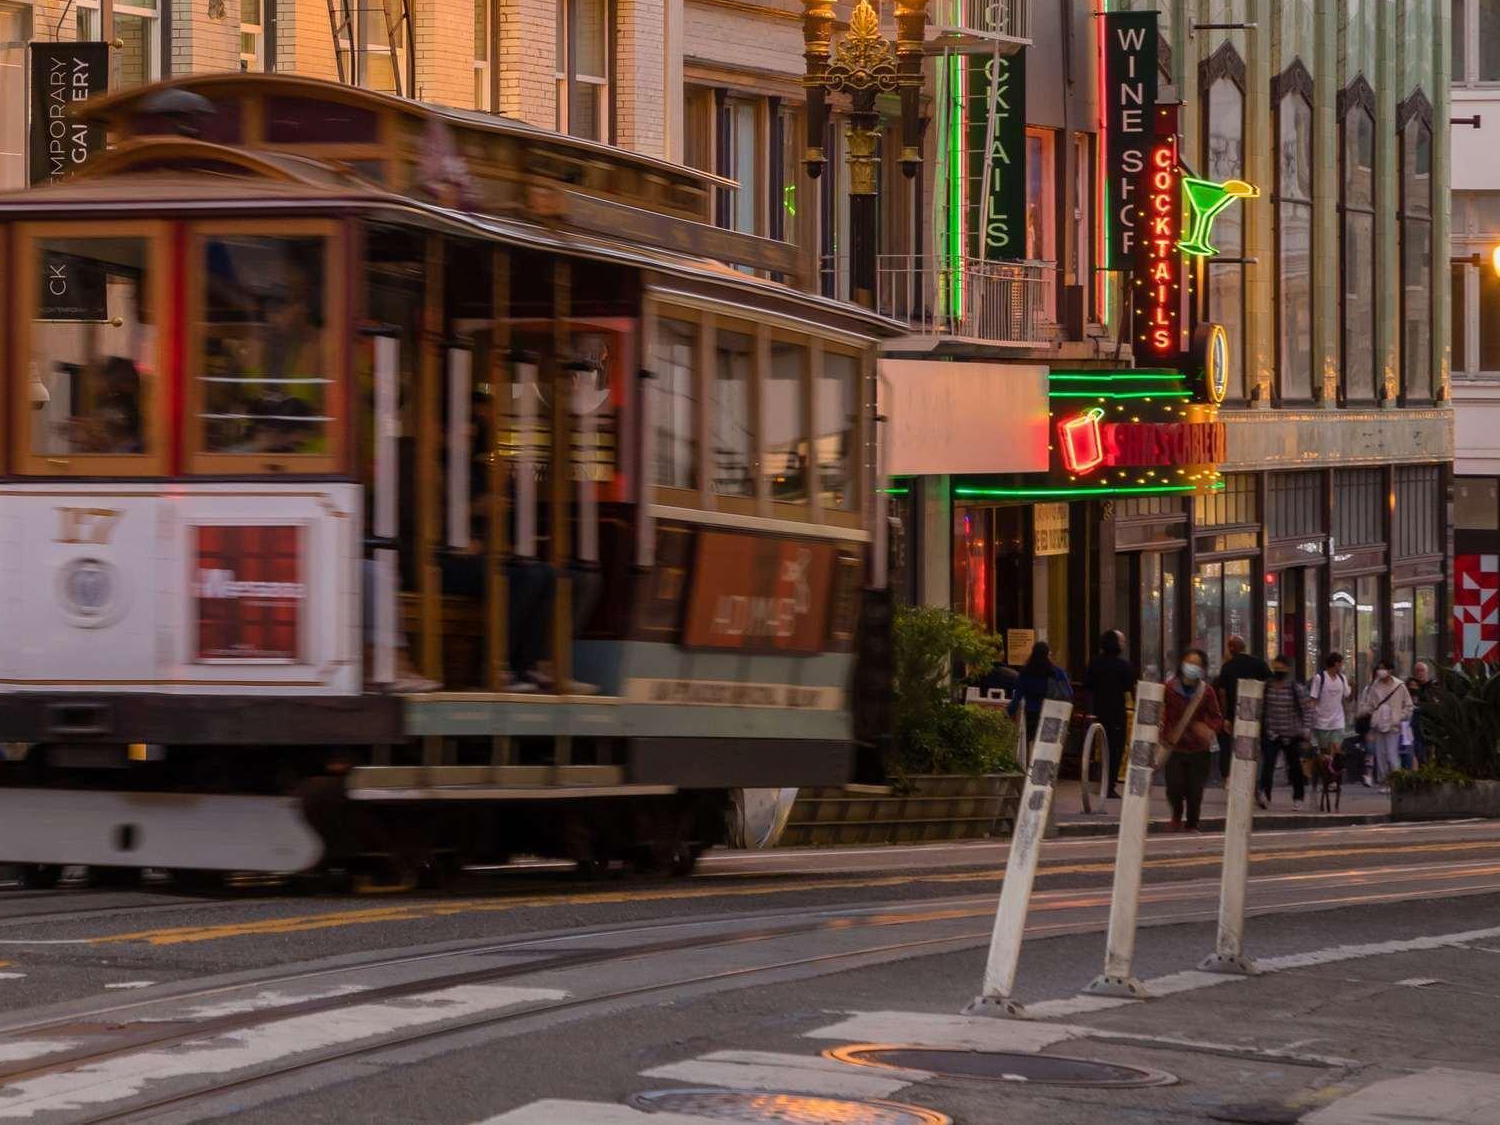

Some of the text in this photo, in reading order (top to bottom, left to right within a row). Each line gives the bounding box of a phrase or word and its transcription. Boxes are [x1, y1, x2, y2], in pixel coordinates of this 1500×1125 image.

[71, 57, 90, 164] GALERY
[984, 3, 1011, 248] CCKTAILS
[1117, 27, 1146, 133] WINE
[49, 264, 67, 296] CK
[1153, 147, 1172, 350] COCKTAILS
